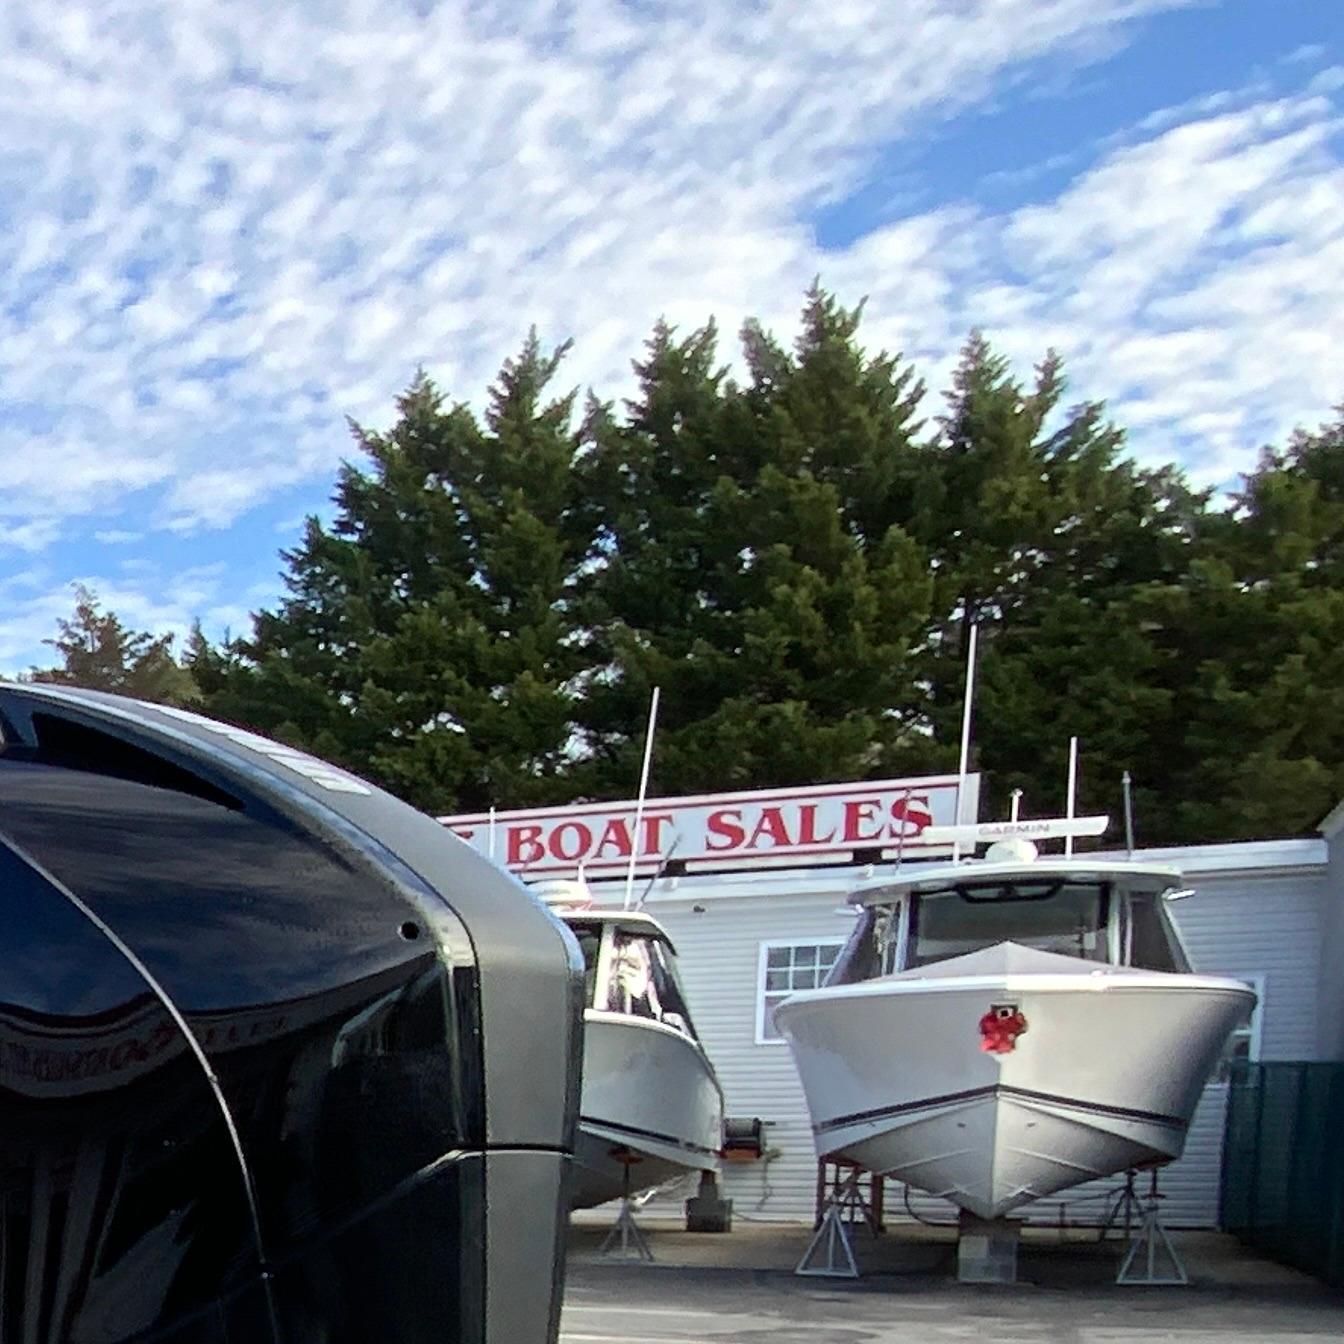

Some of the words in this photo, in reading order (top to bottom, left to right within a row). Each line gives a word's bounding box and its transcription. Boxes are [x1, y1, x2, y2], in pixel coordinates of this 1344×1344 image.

[506, 814, 674, 865] BOAT
[705, 796, 933, 851] SALES
[978, 823, 1050, 835] GARMIN
